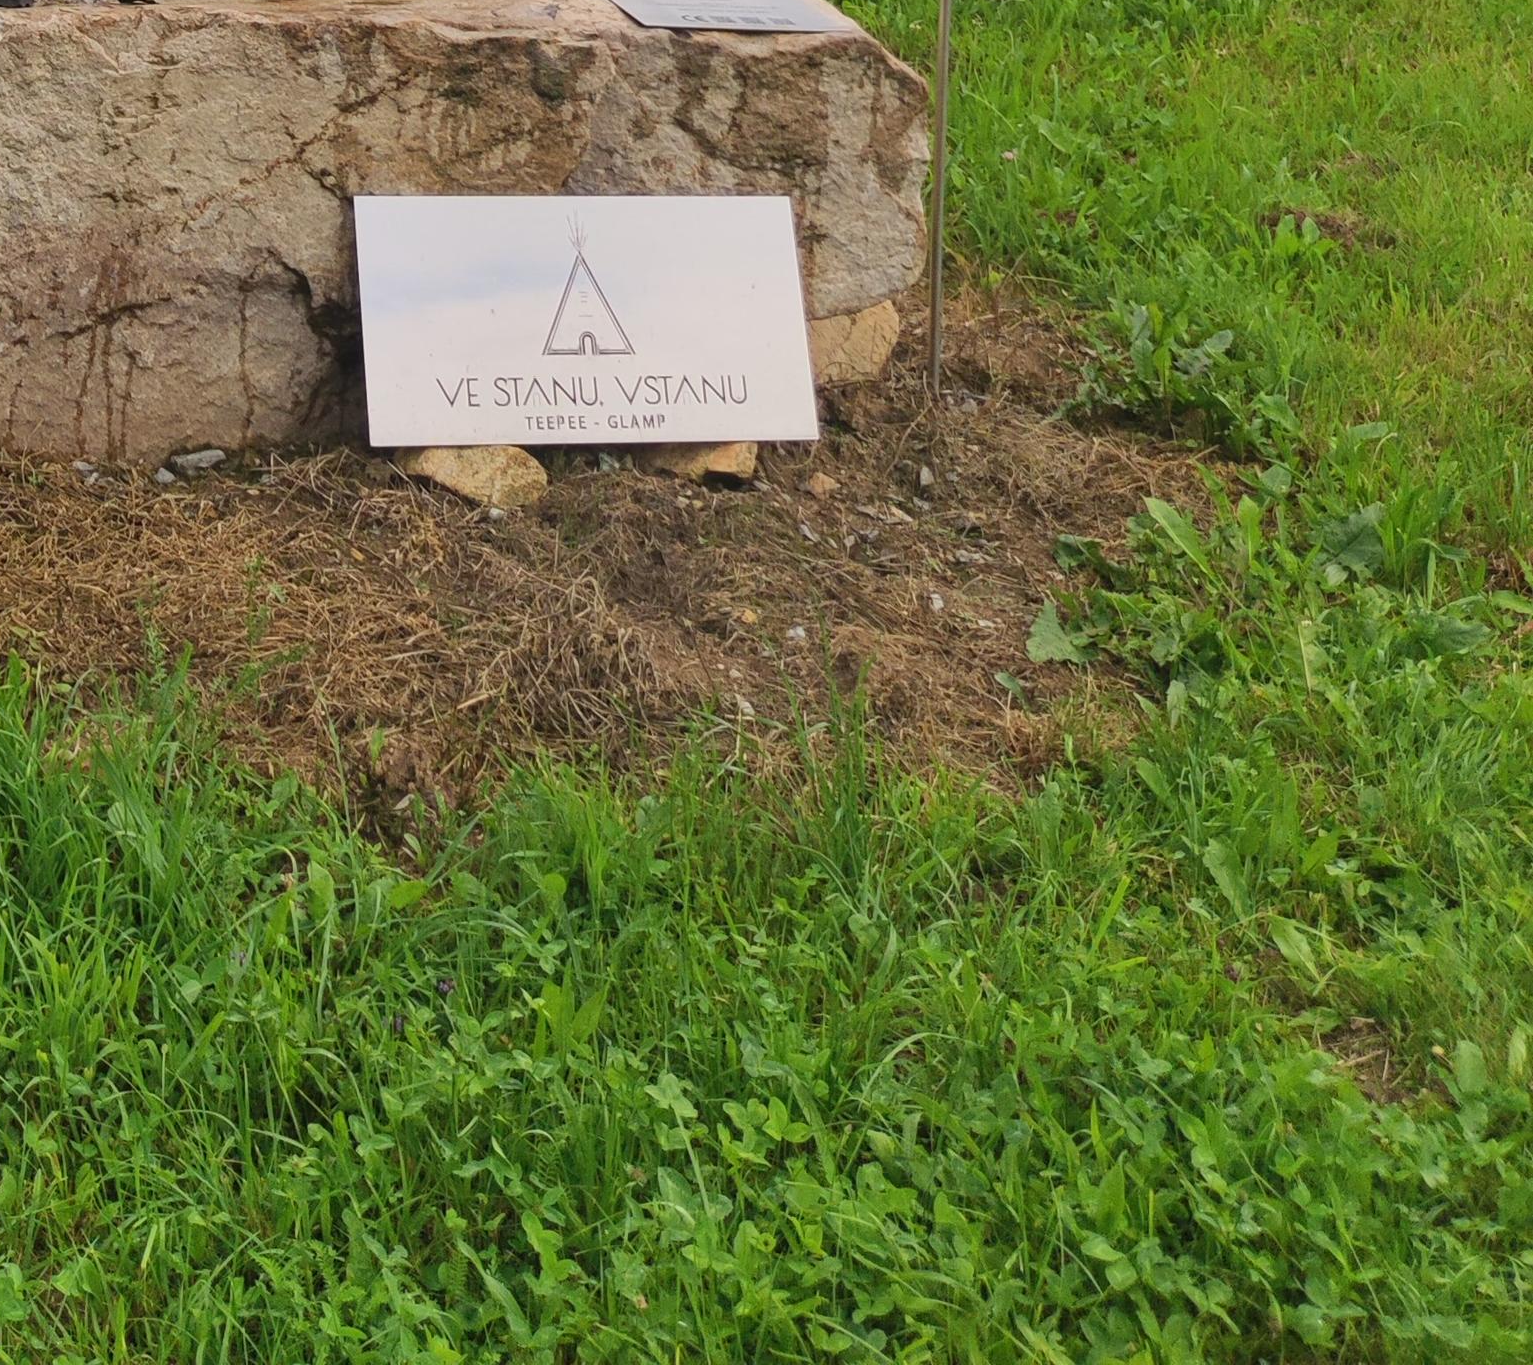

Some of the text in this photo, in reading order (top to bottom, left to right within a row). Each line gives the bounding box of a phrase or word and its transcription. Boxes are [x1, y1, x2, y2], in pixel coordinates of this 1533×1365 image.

[434, 376, 481, 408] VE
[613, 374, 749, 406] VSTANU
[524, 414, 588, 431] TEEPEE
[607, 412, 666, 430] GLAMP
